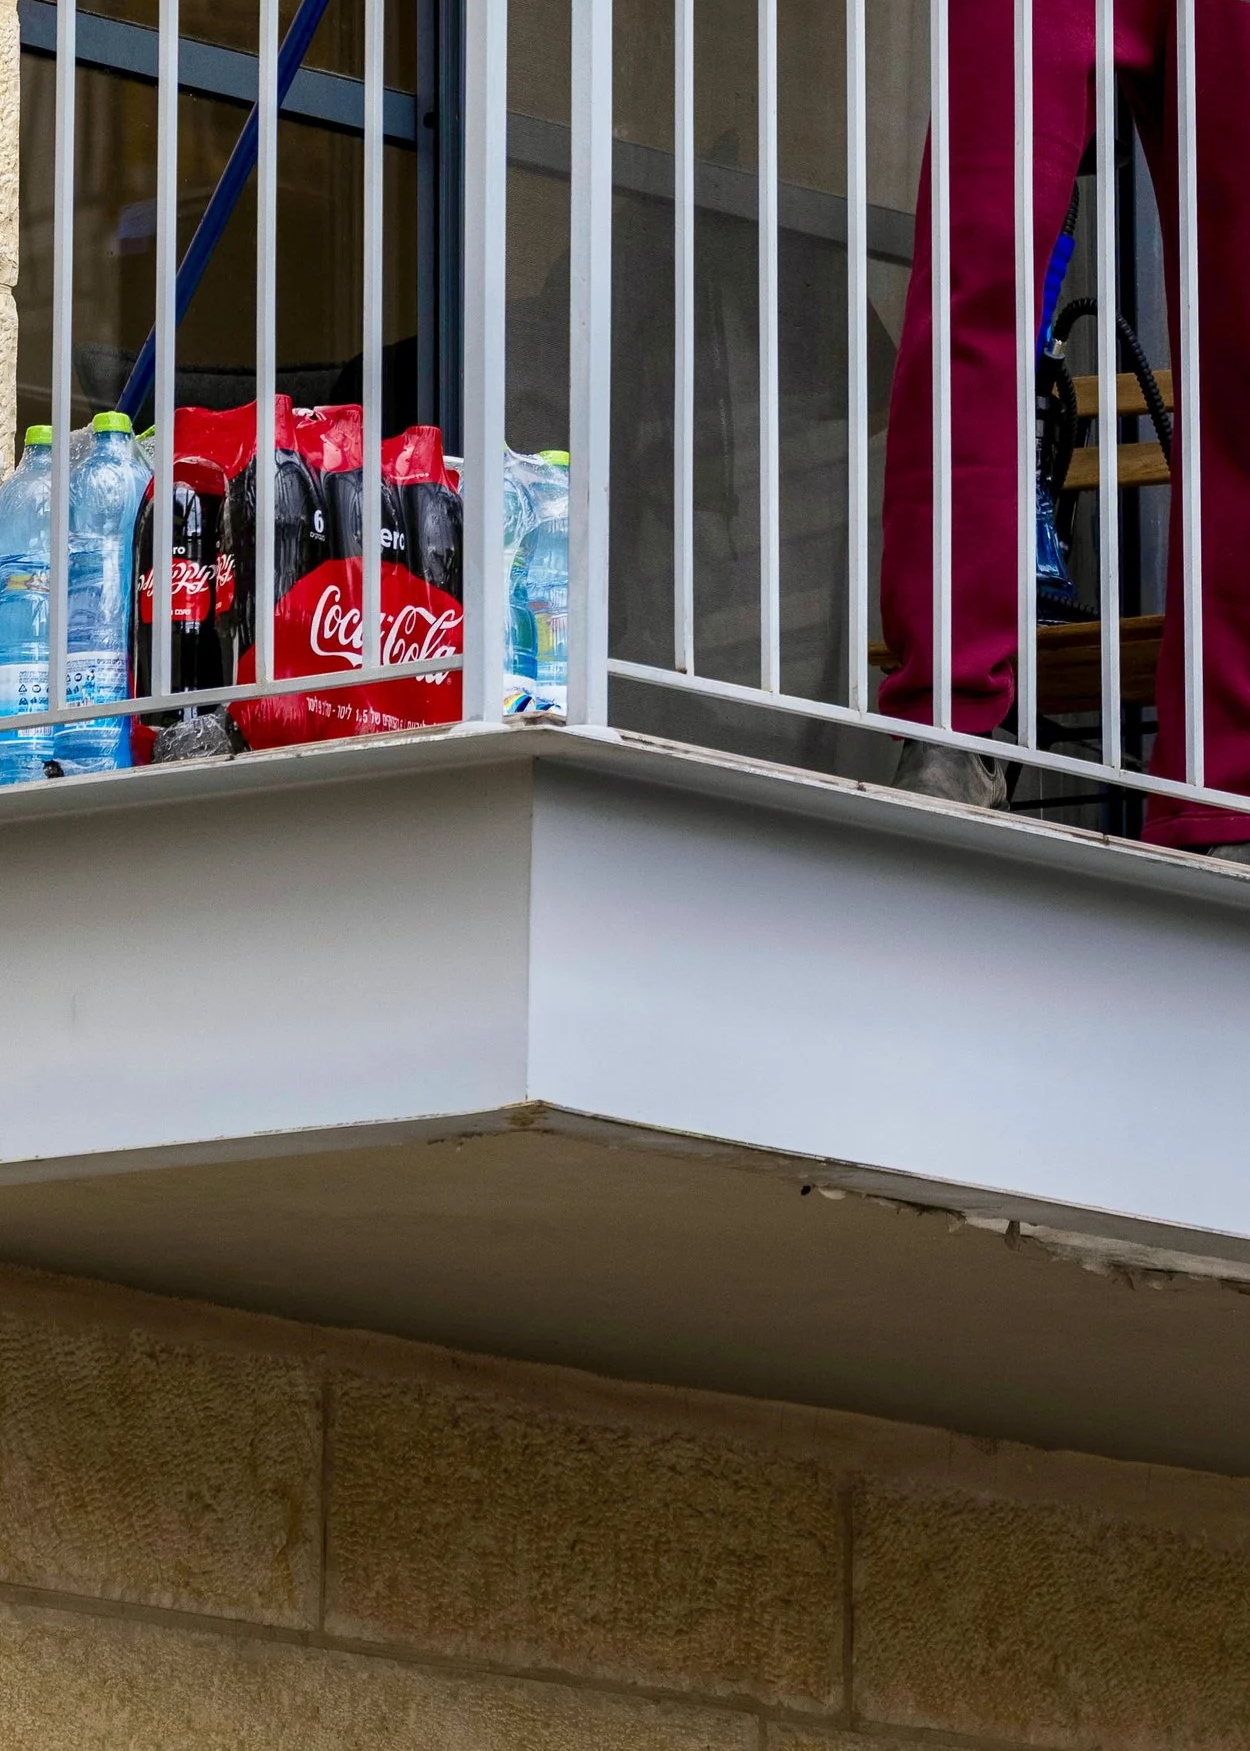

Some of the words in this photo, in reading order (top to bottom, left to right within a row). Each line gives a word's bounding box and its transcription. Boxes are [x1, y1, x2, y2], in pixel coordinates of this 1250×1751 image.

[313, 509, 325, 533] 6
[380, 527, 406, 550] ero
[355, 708, 368, 724] 1.5
